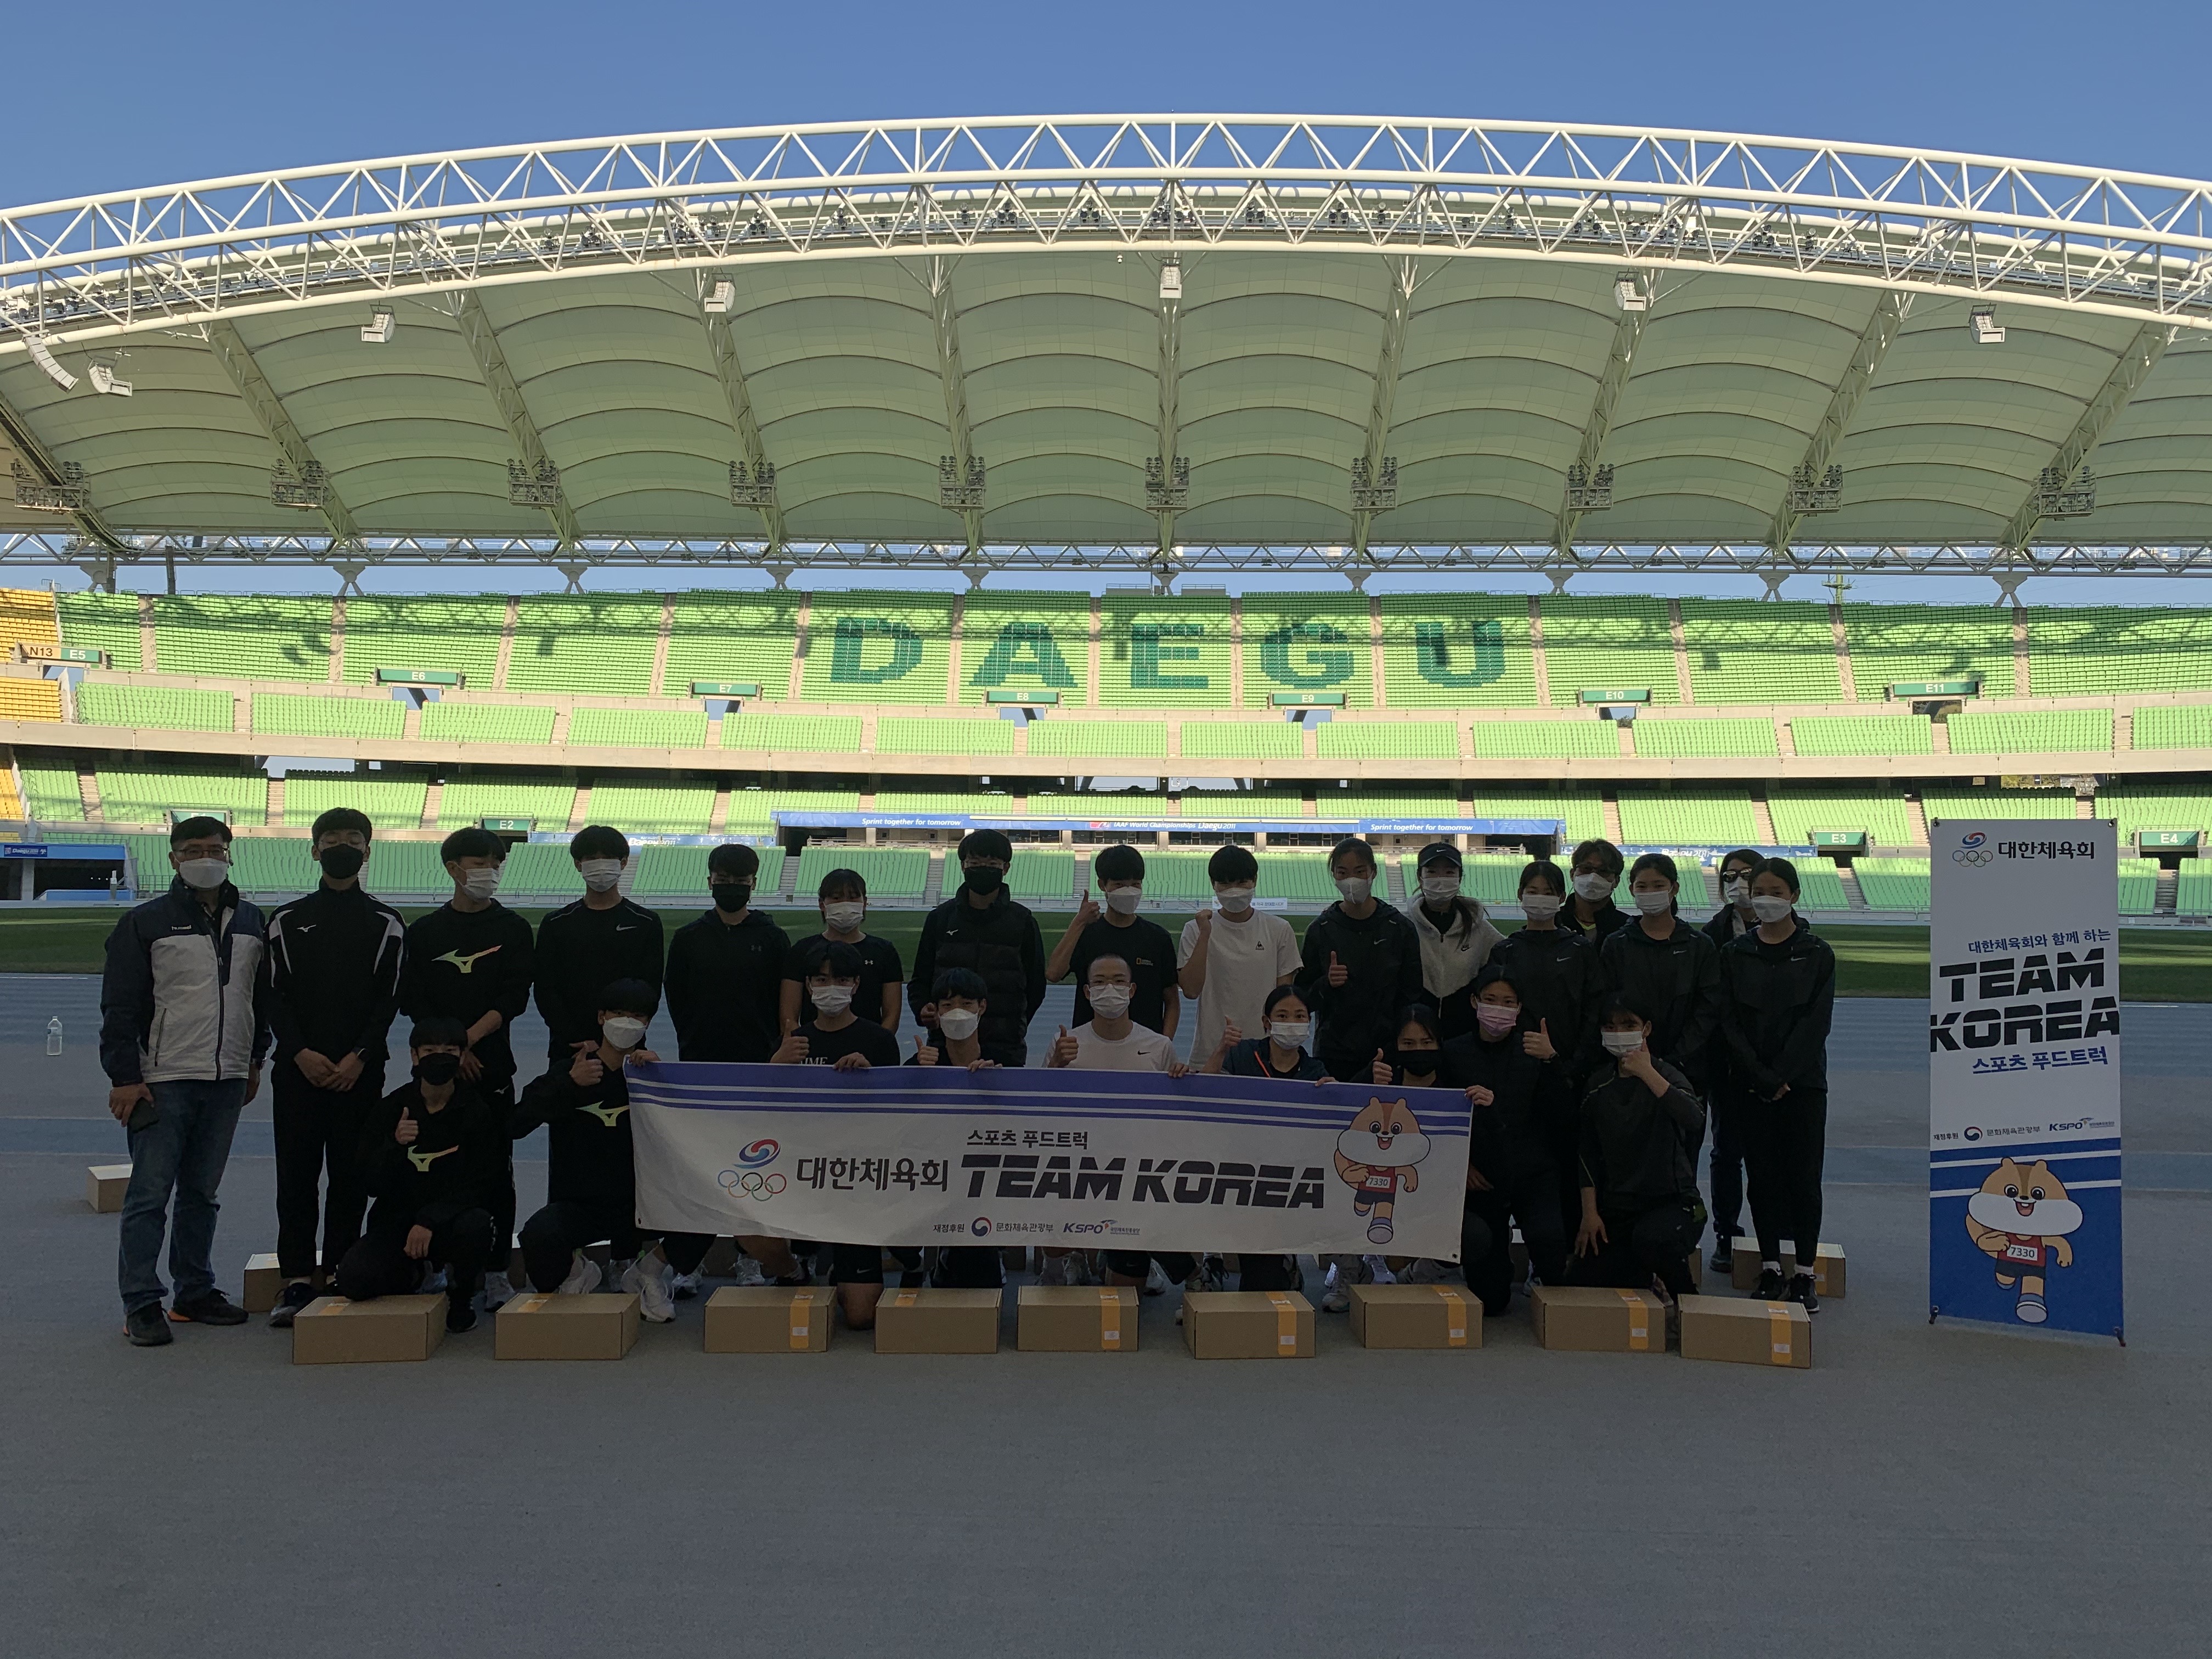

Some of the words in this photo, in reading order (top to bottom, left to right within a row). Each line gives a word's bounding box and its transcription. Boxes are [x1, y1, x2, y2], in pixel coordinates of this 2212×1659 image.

[30, 647, 53, 657] N13
[70, 649, 86, 660] E5
[830, 617, 1505, 689] DAEGU
[411, 672, 426, 681] E6
[719, 684, 732, 693] E7
[1926, 684, 1944, 693] E11
[1017, 692, 1029, 701] E8
[1302, 694, 1314, 703] E9
[1606, 691, 1624, 699] E10
[499, 820, 514, 830] E2
[861, 817, 883, 826] Sprint
[884, 818, 914, 827] together
[1198, 822, 1222, 831] Daegu
[1370, 823, 1392, 832] Sprint
[1393, 823, 1424, 832] together
[1831, 833, 1847, 843] E3
[2160, 833, 2179, 844] E4
[1998, 840, 2096, 860] 대한체육회
[1968, 934, 2047, 954] 대한체육회와
[2051, 930, 2079, 946] 함께
[2084, 929, 2111, 942] 하는
[1939, 947, 2104, 1002] TEAM
[1931, 996, 2120, 1053] KOREA
[1972, 1053, 2028, 1074] 스포츠
[2032, 1046, 2108, 1070] 푸드트럭
[1987, 1126, 2040, 1136] 문화체육관광부
[2049, 1122, 2083, 1131] KSPO
[967, 1129, 1017, 1146] 스포츠
[1022, 1130, 1088, 1149] 푸드트럭
[797, 1156, 949, 1192] 대한체육회
[961, 1154, 1126, 1201] TEAM
[1132, 1158, 1324, 1209] KOREA
[1369, 1177, 1388, 1186] 7330
[933, 1223, 964, 1233] 재정후원
[996, 1222, 1054, 1233] 문화체육관광부
[1063, 1222, 1103, 1234] KSPO
[2010, 1246, 2035, 1258] 7330
